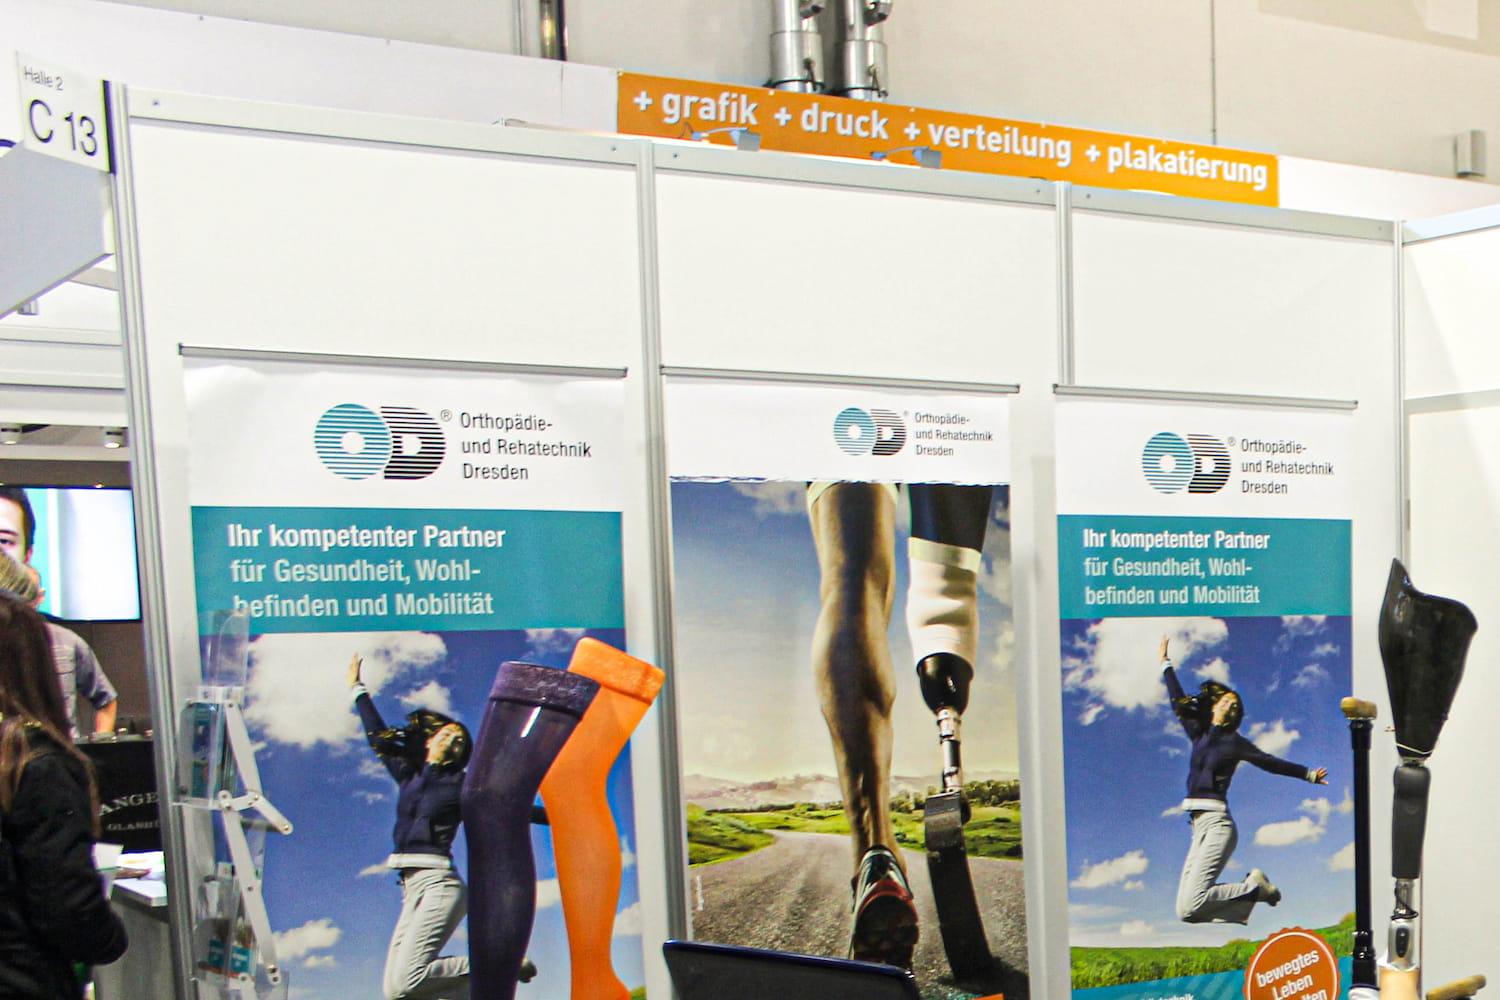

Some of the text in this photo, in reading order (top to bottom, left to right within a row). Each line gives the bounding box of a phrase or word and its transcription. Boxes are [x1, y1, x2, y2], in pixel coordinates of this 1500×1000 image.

[24, 66, 63, 91] Halle 2
[29, 99, 97, 156] C 13
[661, 91, 758, 125] grafik
[801, 103, 889, 140] druck
[929, 122, 1072, 168] verteilung
[1107, 142, 1268, 191] plakatierung
[460, 411, 553, 432] Orthopädie-
[915, 412, 970, 427] Orthopädie-
[916, 429, 993, 442] und Rehatechnik
[462, 438, 592, 458] und Rehatechnik
[916, 445, 954, 456] Dresden
[1241, 439, 1307, 455] Orthopädie-
[463, 463, 529, 480] Dresden
[1242, 461, 1334, 475] und Rehatechnik
[1242, 481, 1288, 494] Dresden
[228, 524, 505, 551] Ihr kompetenter Partner
[1083, 529, 1270, 552] Ihr kompetenter Partner
[231, 559, 481, 584] für Gesundheit, Wohl-
[1084, 557, 1252, 579] für Gesundheit, Wohl-
[1085, 584, 1260, 605] befinden und Mobilität
[234, 593, 493, 618] befinden und Mobilität
[1257, 949, 1319, 987] bewegtes
